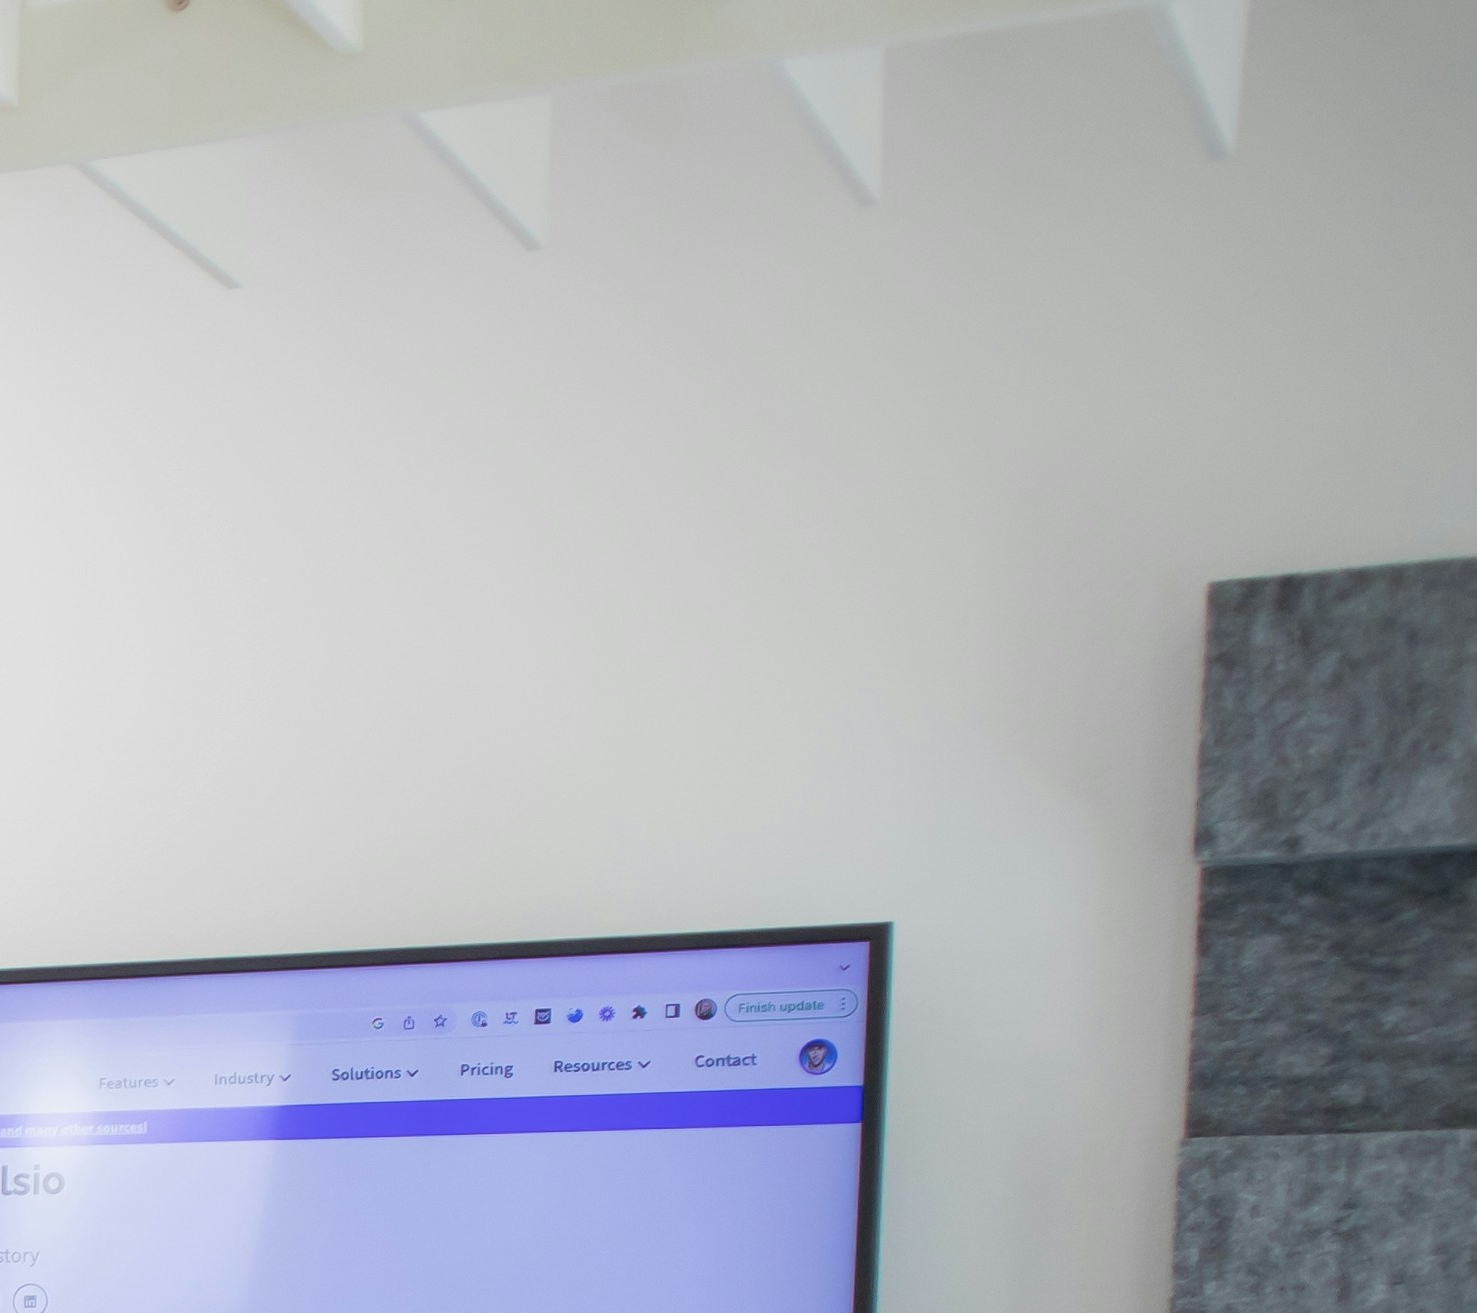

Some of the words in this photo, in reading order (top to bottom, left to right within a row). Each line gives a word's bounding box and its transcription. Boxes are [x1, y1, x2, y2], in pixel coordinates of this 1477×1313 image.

[737, 1001, 776, 1015] Finish
[779, 999, 826, 1016] update
[97, 1076, 160, 1091] Features
[213, 1071, 276, 1088] Industry
[330, 1066, 402, 1082] Solutions
[459, 1062, 514, 1080] Pricing
[553, 1058, 633, 1074] Resources
[694, 1053, 758, 1069] Contact
[0, 1124, 23, 1139] and
[95, 1119, 148, 1136] sources!
